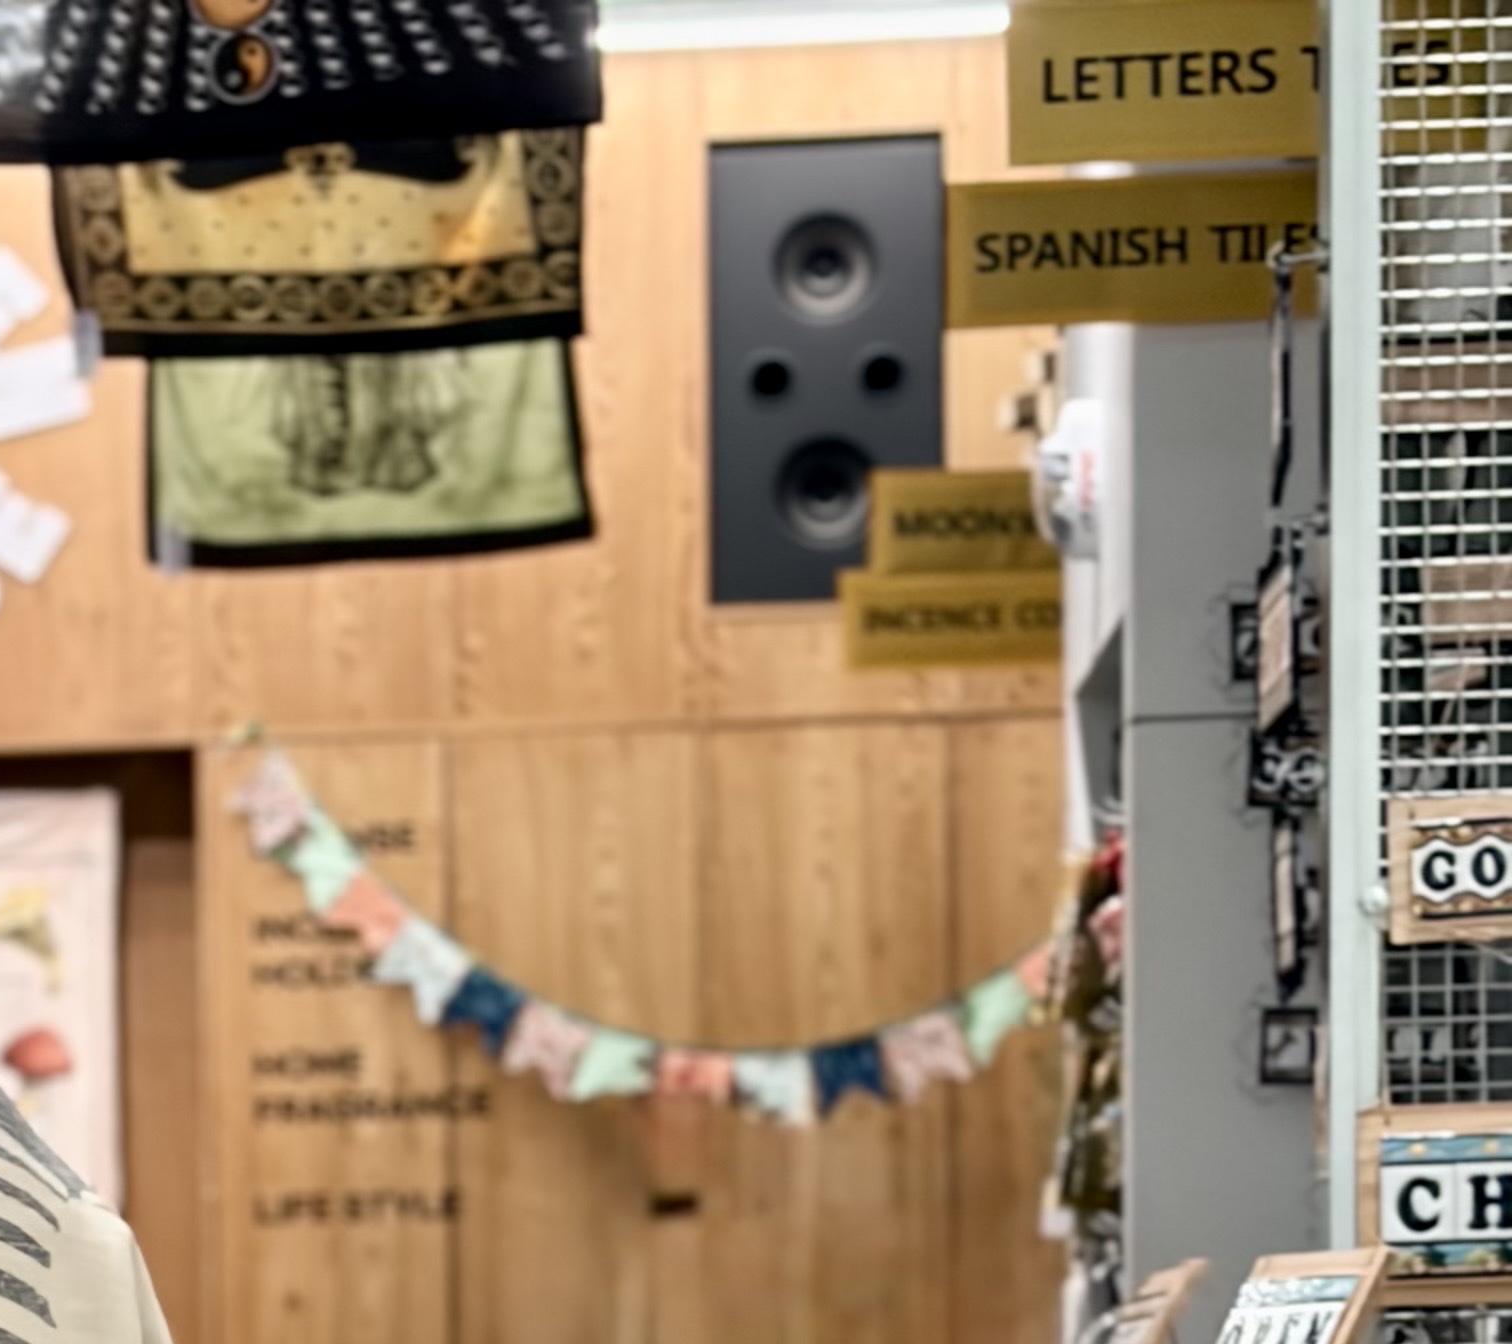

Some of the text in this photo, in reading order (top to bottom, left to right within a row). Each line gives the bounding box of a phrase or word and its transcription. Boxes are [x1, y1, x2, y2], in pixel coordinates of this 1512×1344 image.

[1042, 48, 1278, 103] LETTERS
[975, 227, 1189, 273] SPANISH
[1420, 844, 1507, 892] GO
[1396, 1172, 1512, 1234] CH
